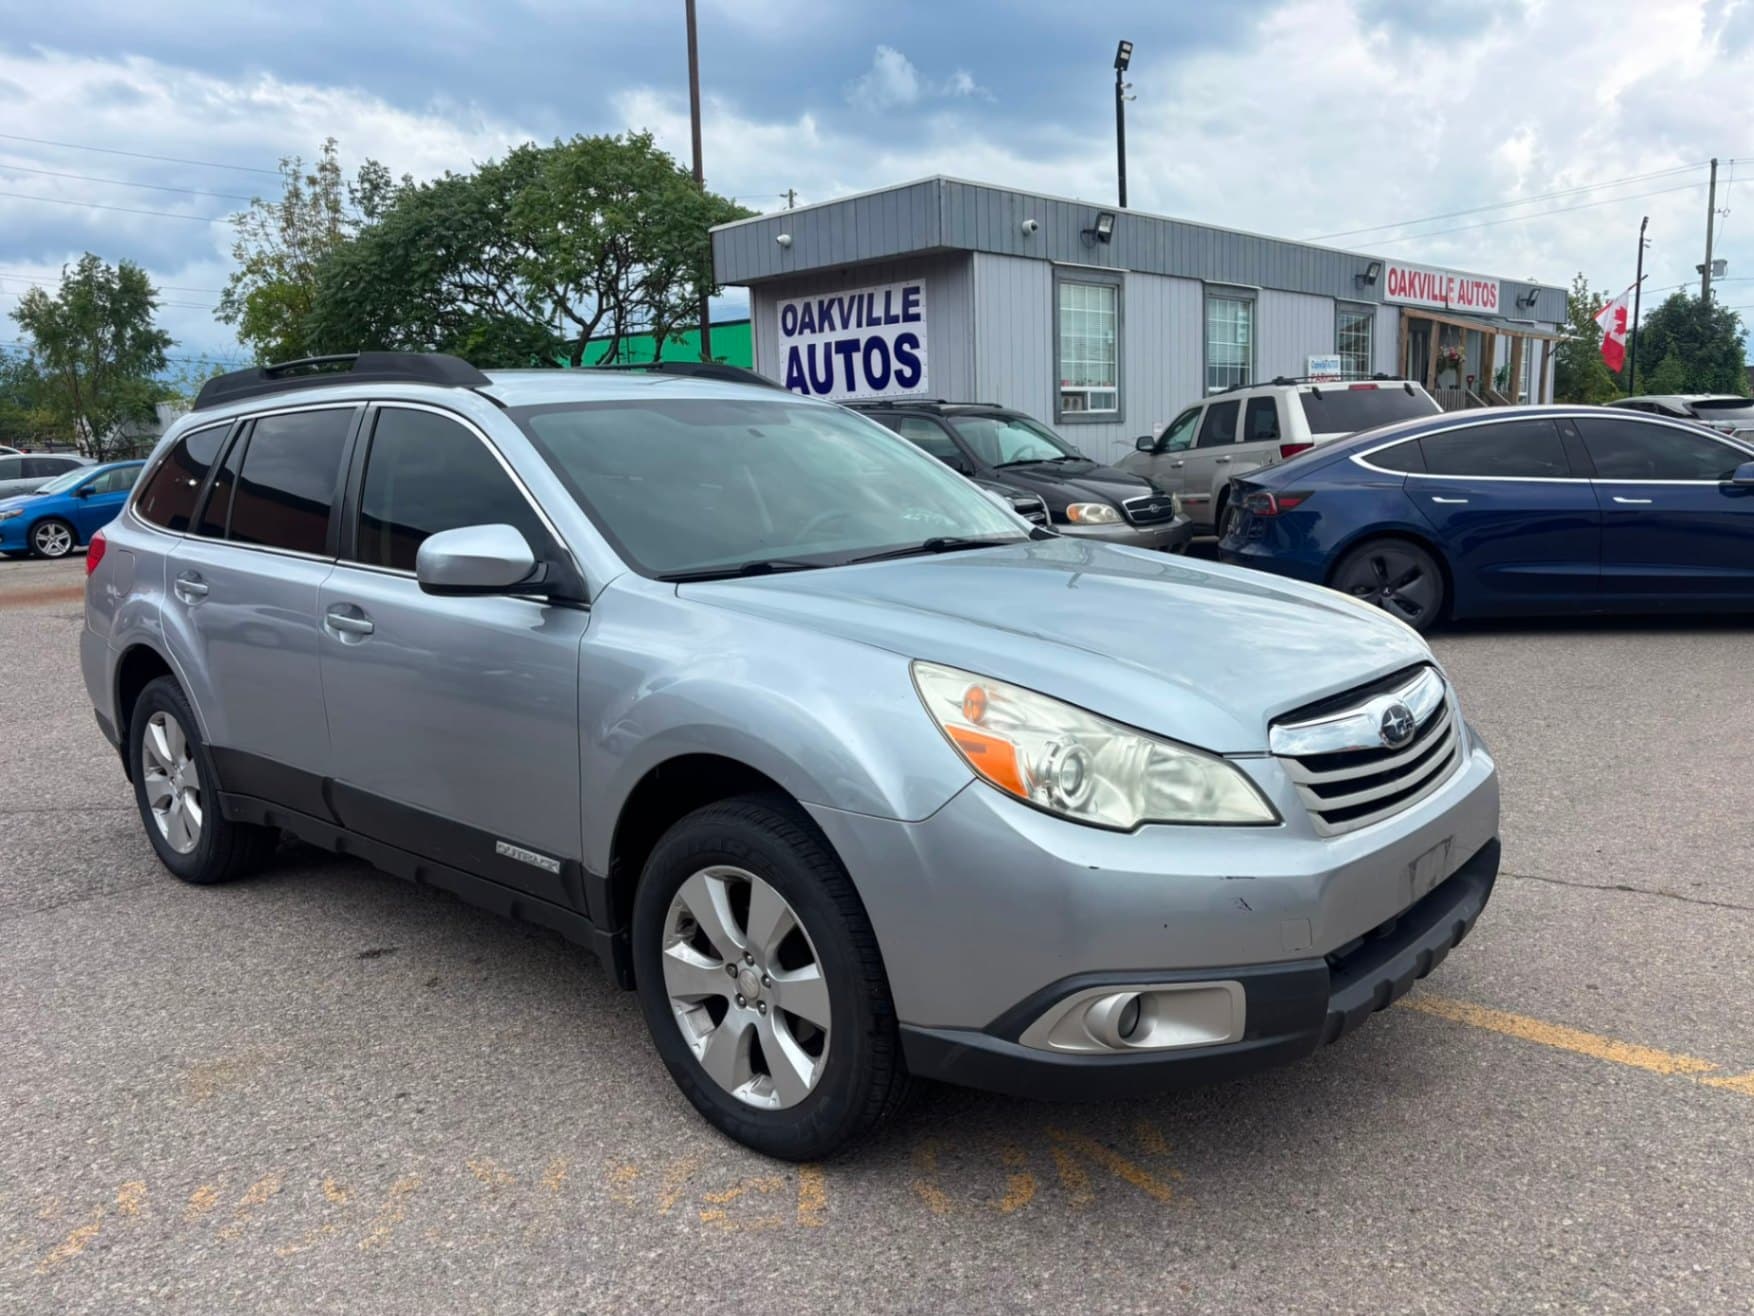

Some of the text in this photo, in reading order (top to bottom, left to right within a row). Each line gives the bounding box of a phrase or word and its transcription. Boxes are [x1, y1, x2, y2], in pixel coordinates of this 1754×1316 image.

[781, 286, 922, 337] OAKVILLE
[1388, 267, 1497, 308] OAKVILLE AUTOS
[785, 332, 922, 395] AUTOS
